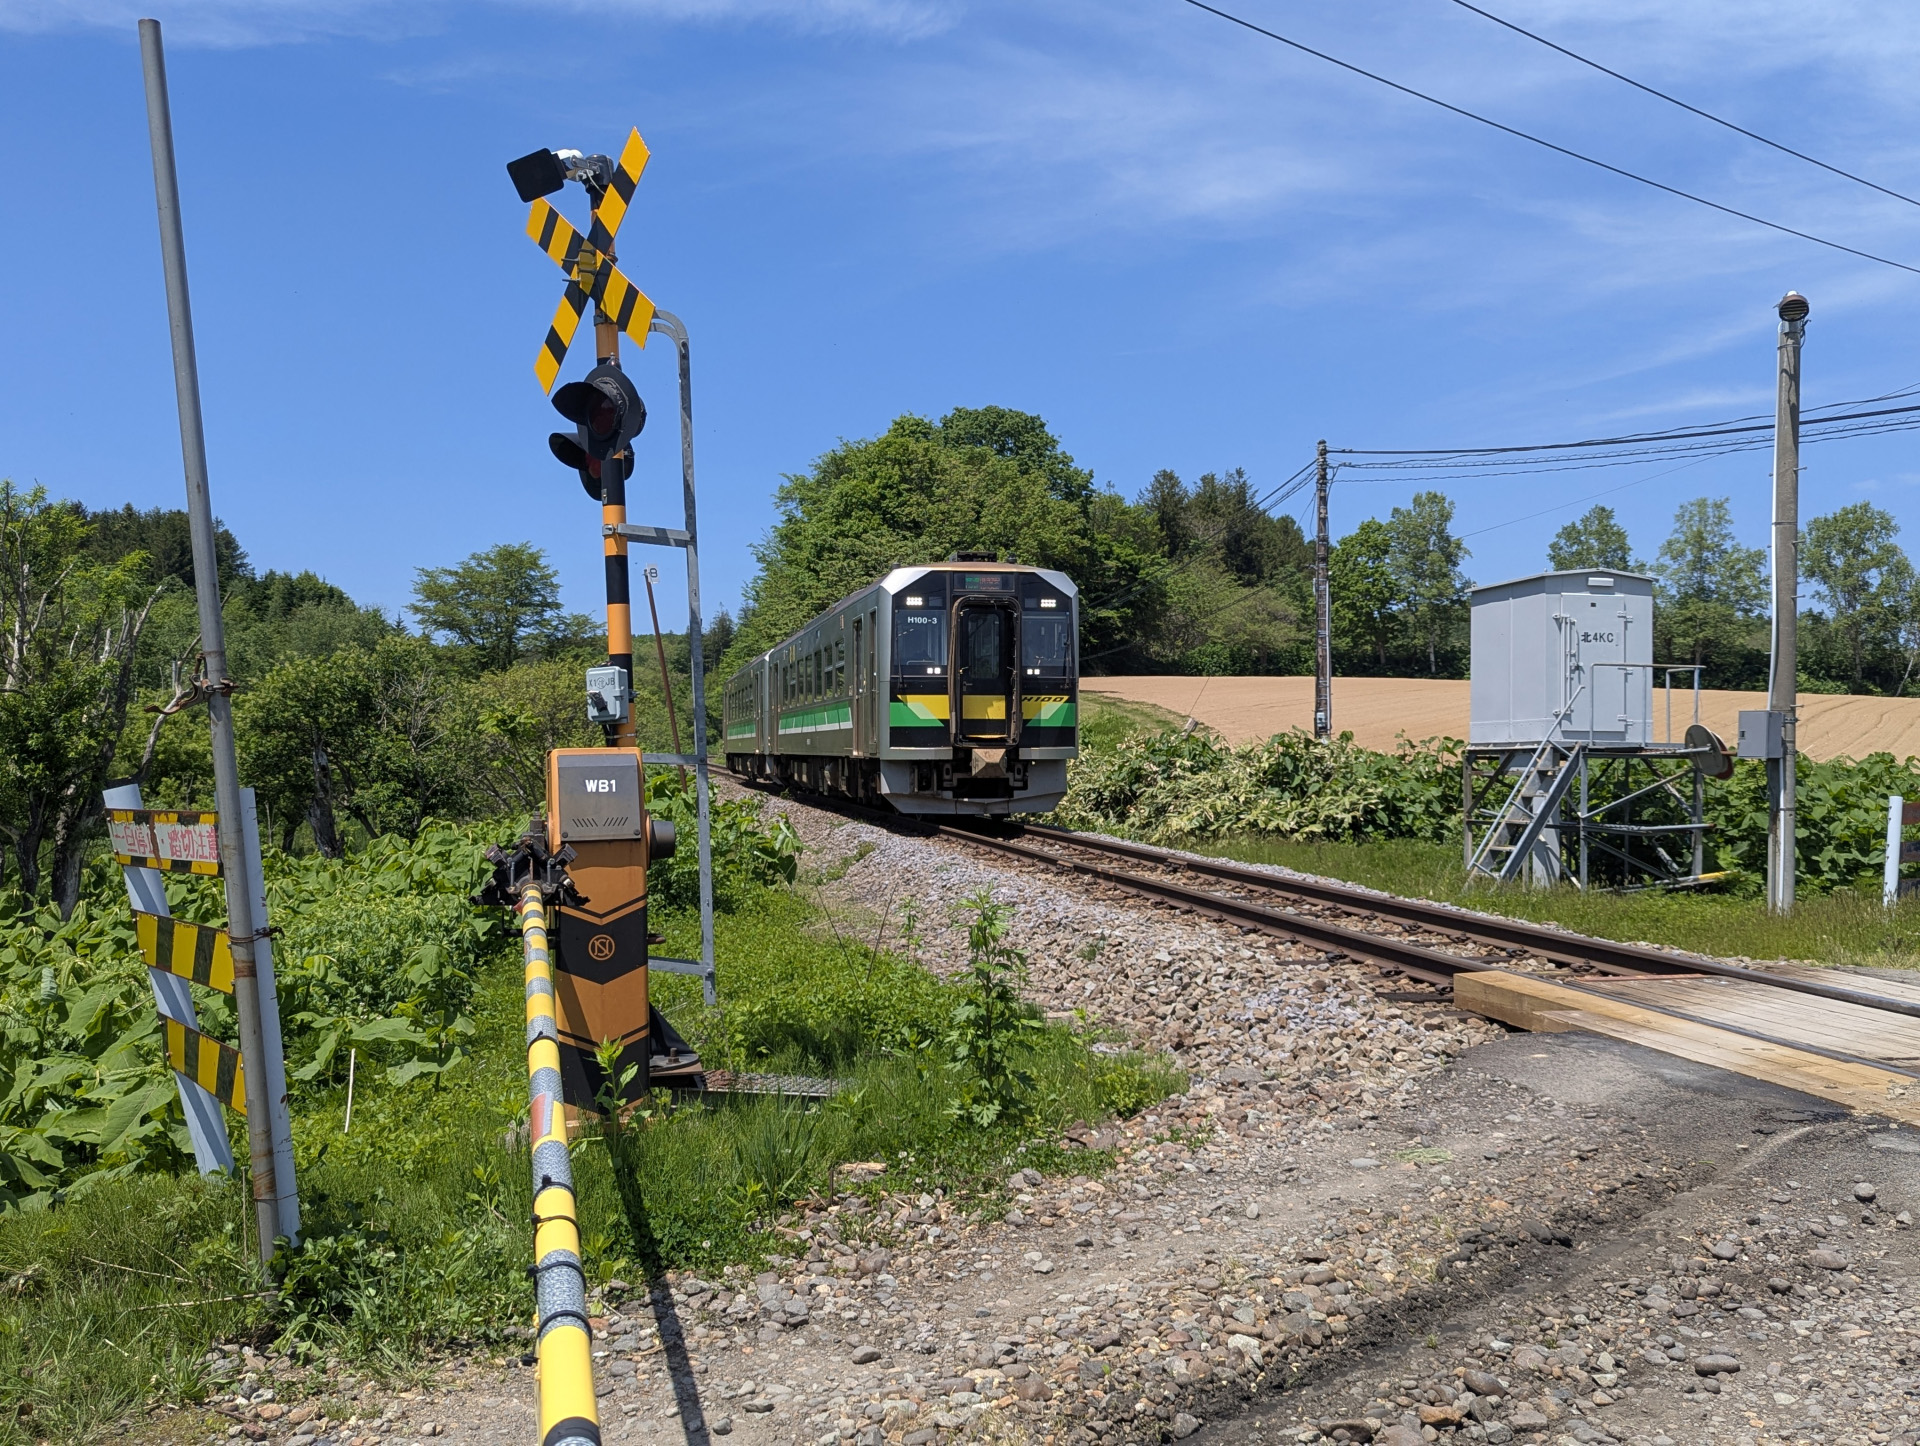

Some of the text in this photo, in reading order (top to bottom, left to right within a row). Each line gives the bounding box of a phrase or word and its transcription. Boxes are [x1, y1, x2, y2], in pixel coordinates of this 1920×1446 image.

[907, 616, 938, 624] H100-3
[1580, 631, 1614, 643] 北4KC
[585, 779, 616, 793] WB1
